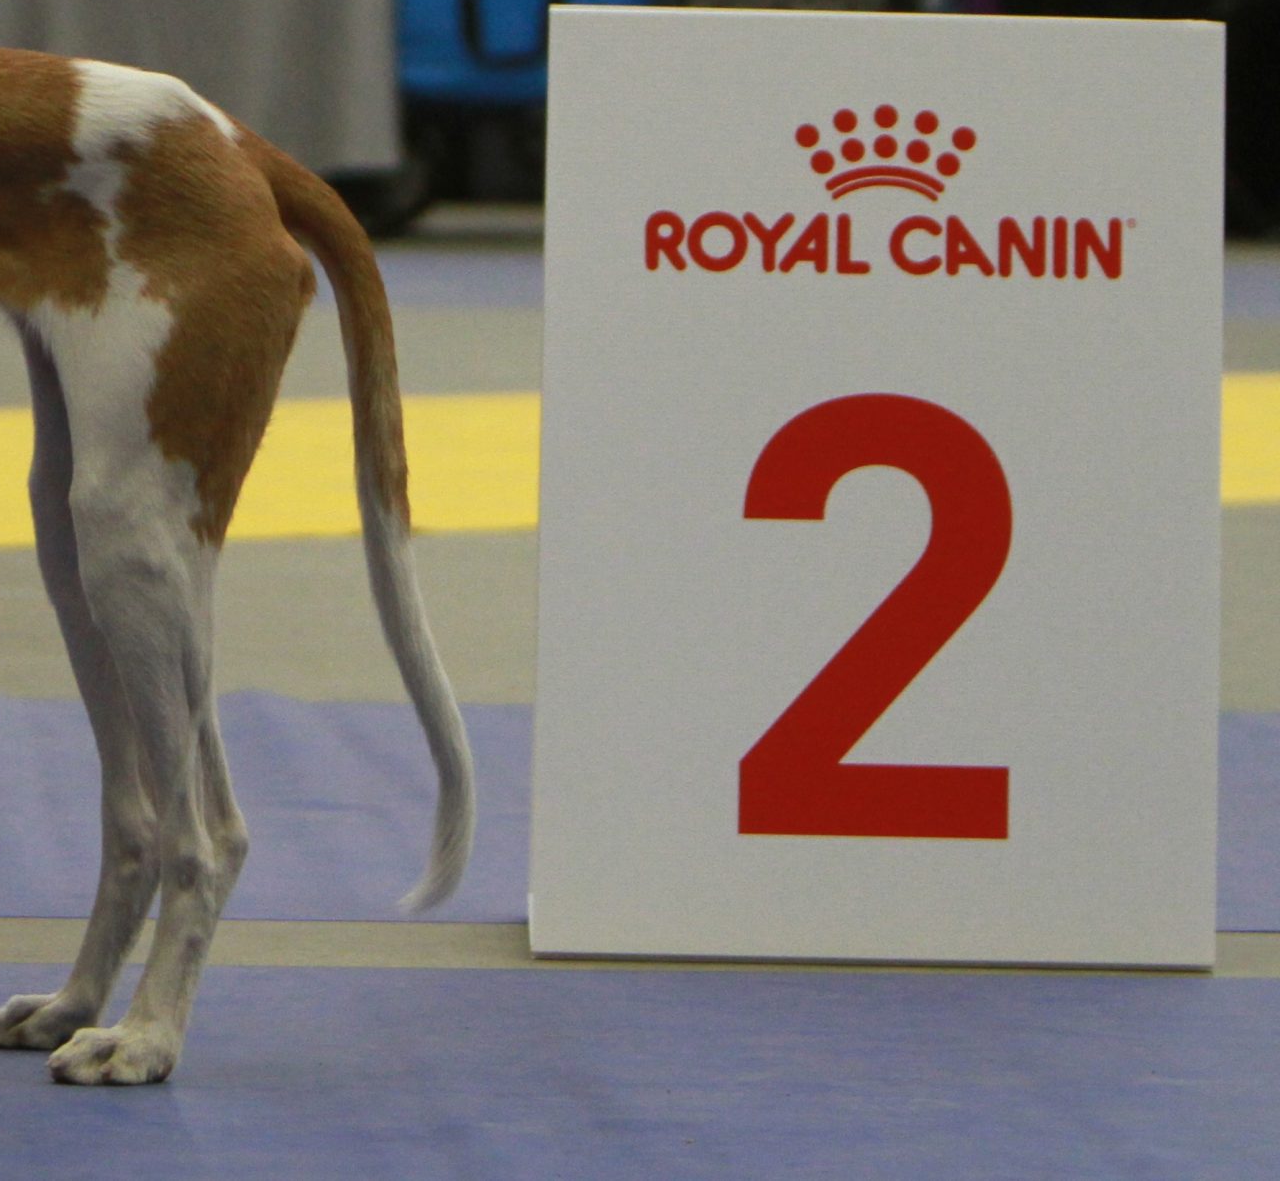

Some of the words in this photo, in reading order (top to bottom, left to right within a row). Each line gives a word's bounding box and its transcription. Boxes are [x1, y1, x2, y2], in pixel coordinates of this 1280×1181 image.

[645, 210, 871, 274] ROYAL
[889, 215, 1122, 279] CANIN
[738, 393, 1013, 840] 2
